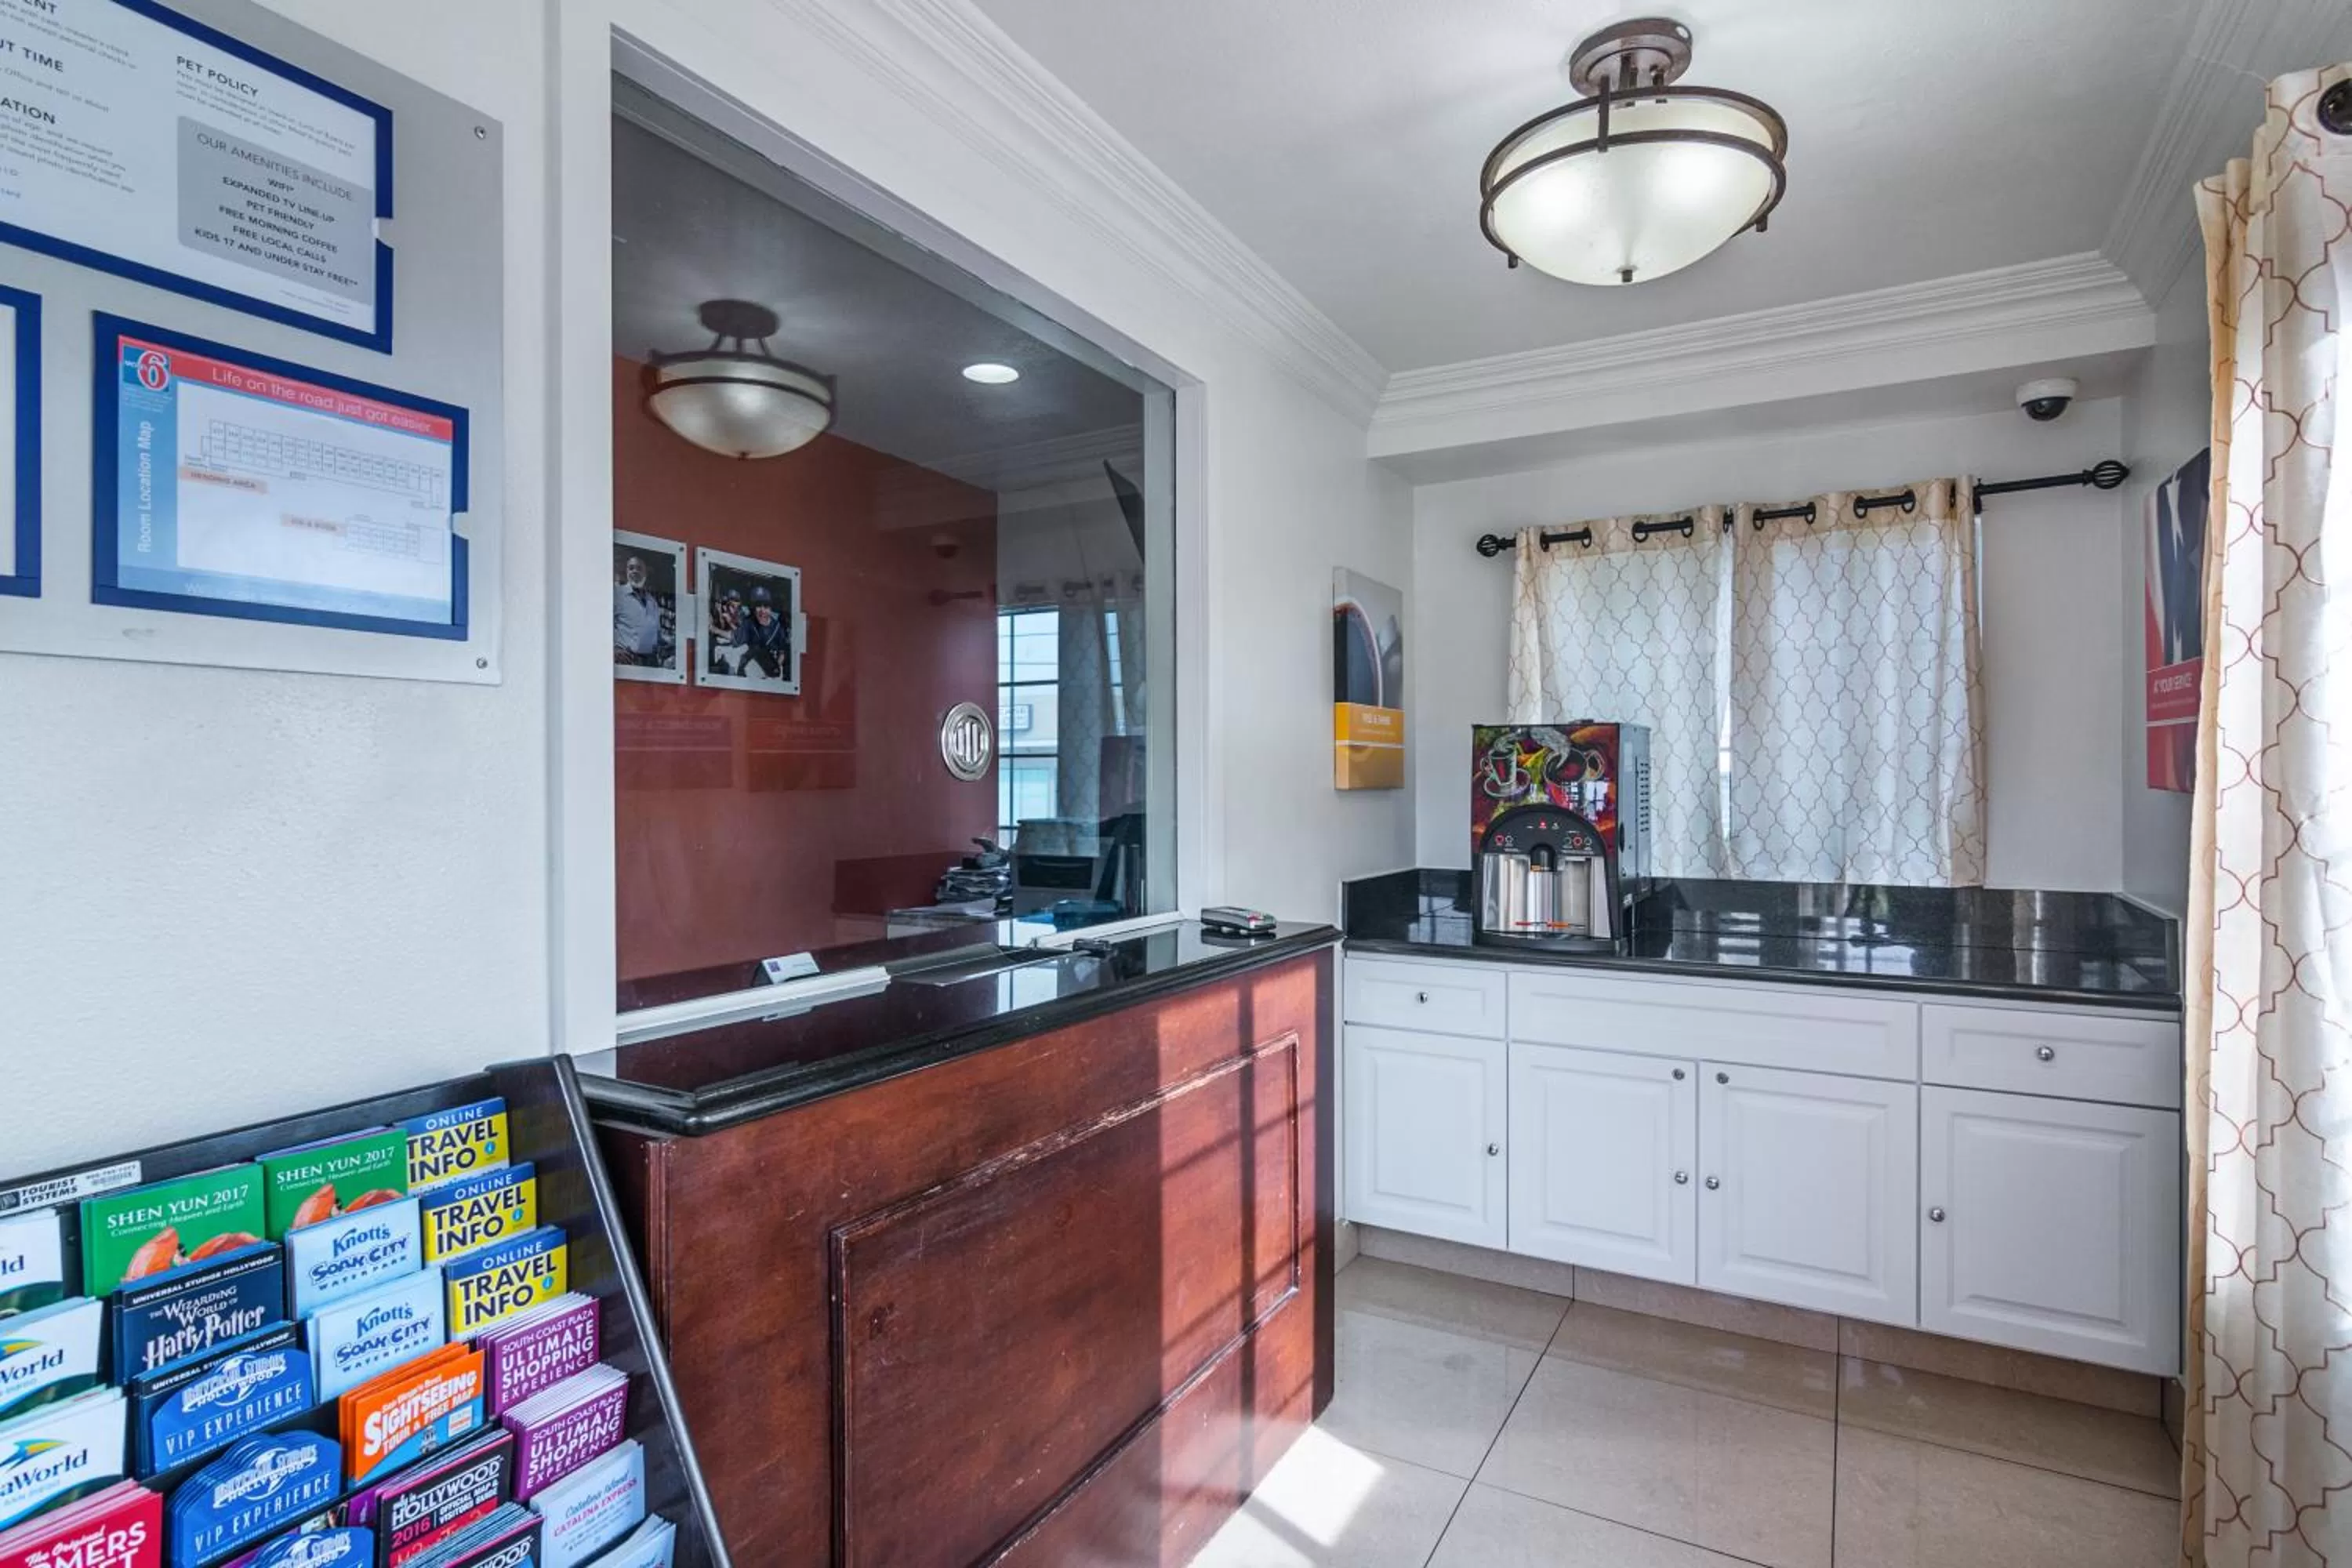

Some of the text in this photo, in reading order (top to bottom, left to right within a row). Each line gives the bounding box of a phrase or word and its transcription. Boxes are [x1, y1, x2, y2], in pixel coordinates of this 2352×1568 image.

[23, 46, 64, 73] TIME
[176, 56, 259, 97] PET POLICY
[197, 132, 353, 201] OUR AMENITIES INCLUDE
[222, 176, 280, 204] EXPANDED
[283, 198, 296, 209] TV
[219, 205, 339, 254] FREE MORNING COFFEE
[246, 200, 315, 230] PET FRIENDLY
[194, 227, 220, 243] KIDS
[223, 237, 235, 247] 17
[238, 242, 263, 256] AND
[264, 250, 299, 269] UNDER
[303, 262, 325, 277] STAY
[233, 225, 327, 263] FREE LOCAL CALLS
[138, 350, 169, 390] 6
[212, 367, 241, 387] Life
[247, 379, 267, 392] on
[270, 383, 296, 400] the
[299, 390, 333, 409] road
[338, 401, 361, 417] just
[365, 408, 389, 423] got
[137, 420, 154, 554] Room Location Map
[426, 1106, 484, 1130] ONLINE
[408, 1120, 499, 1159] TRAVEL
[277, 1145, 395, 1185] SHEN YUN 2017
[410, 1148, 476, 1183] INFO
[22, 1177, 76, 1197] TOURIST
[22, 1185, 78, 1207] SYSTEMS
[107, 1184, 249, 1229] SHEN YUN 2017
[433, 1185, 526, 1230] TRAVEL
[454, 1174, 513, 1200] ONLINE
[332, 1223, 390, 1258] Knott's
[368, 1237, 408, 1263] CITY
[437, 1216, 504, 1254] INFO
[482, 1241, 543, 1269] ONLINE
[132, 1254, 274, 1305] UNIVERSAL STUDIOS HOLLYWOOD
[459, 1254, 557, 1301] TRAVEL
[179, 1300, 227, 1328] WORLD
[356, 1301, 414, 1339] Knott's
[464, 1284, 534, 1326] INFO
[142, 1306, 267, 1372] Harry Potter
[391, 1317, 430, 1343] CITY
[501, 1309, 593, 1356] SOUTH COAST PLAZA
[501, 1319, 594, 1372] ULTIMATE
[152, 1369, 201, 1391] UNIVERSAL
[501, 1351, 594, 1404] EXPERIENCE
[502, 1335, 593, 1390] SHOPPING
[166, 1383, 302, 1456] VIP EXPERIENCE
[363, 1370, 477, 1457] SIGHTSEEING
[530, 1400, 623, 1460] ULTIMATE
[532, 1390, 624, 1443] SOUTH COAST PLAZA
[526, 1432, 619, 1490] EXPERIENCE
[528, 1417, 621, 1476] SHOPPING
[195, 1525, 223, 1552] VIP
[233, 1472, 331, 1535] EXPERIENCE
[392, 1460, 500, 1527] HOLLYWOOD
[439, 1500, 475, 1524] VISITORS
[440, 1493, 472, 1515] OFFICIAL
[474, 1482, 492, 1497] MAP
[392, 1516, 430, 1549] 2016
